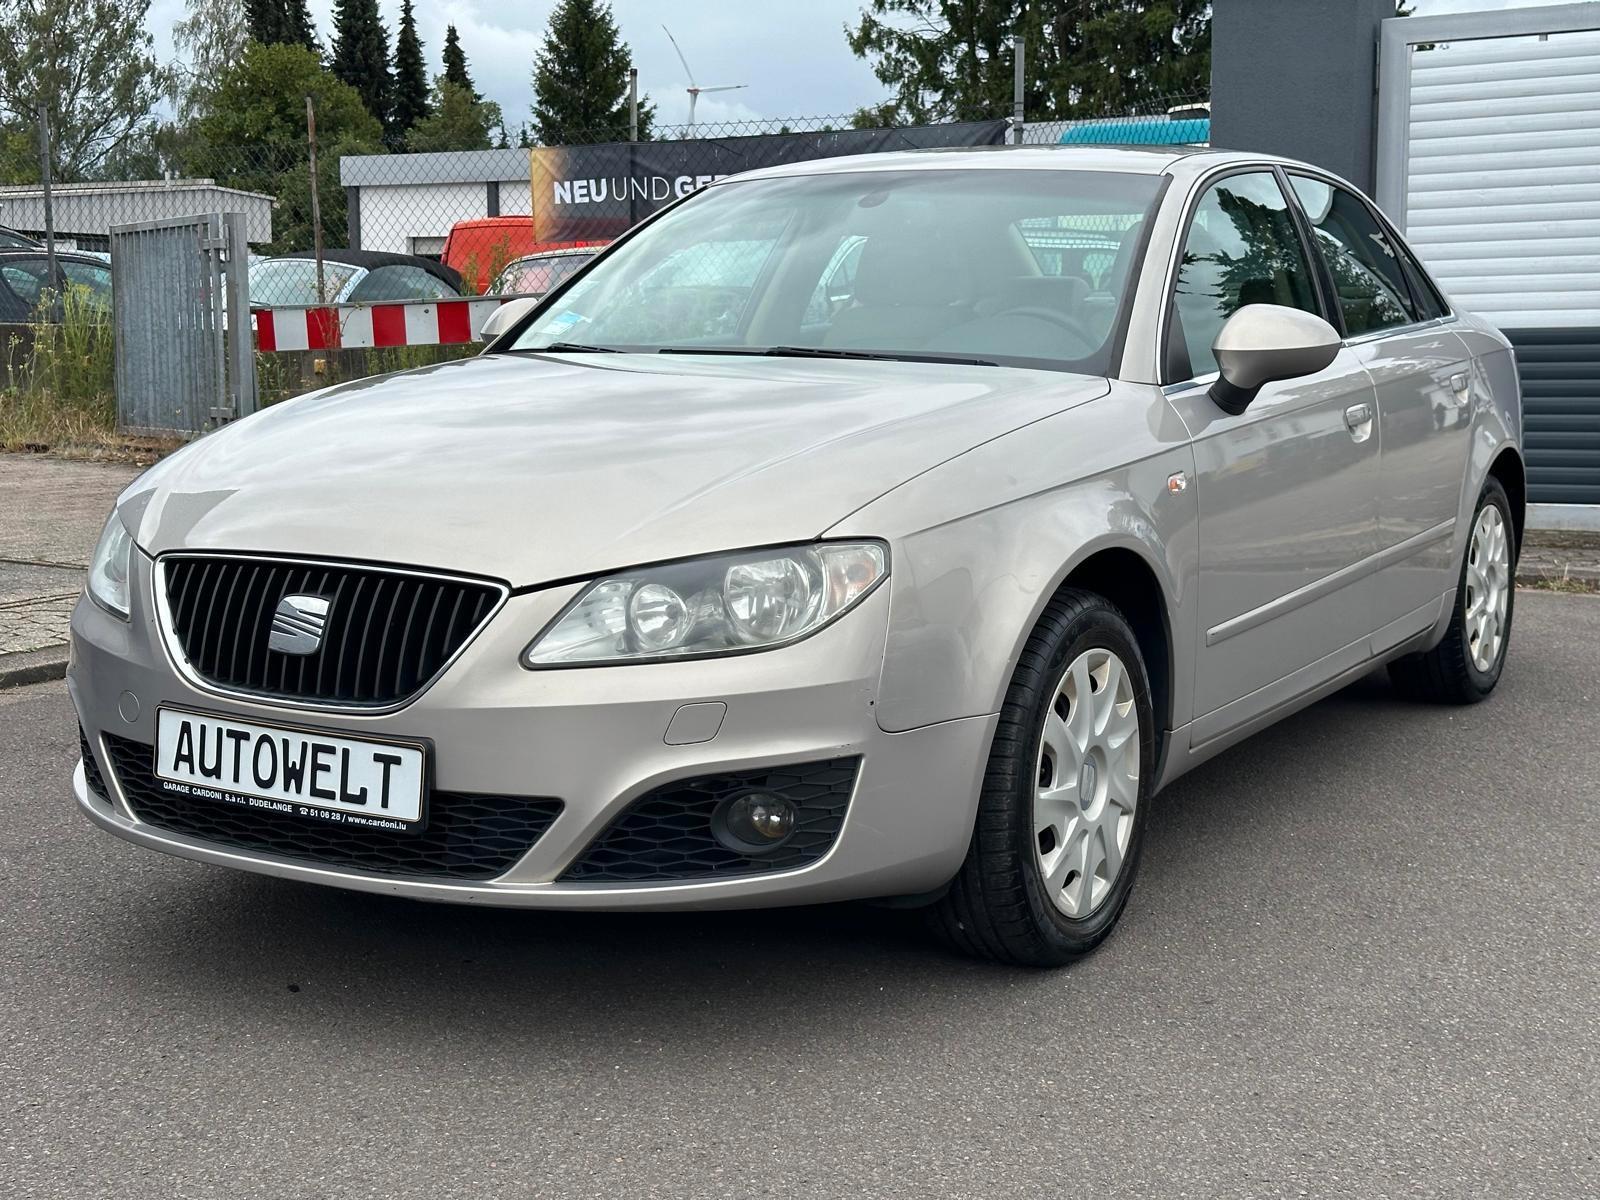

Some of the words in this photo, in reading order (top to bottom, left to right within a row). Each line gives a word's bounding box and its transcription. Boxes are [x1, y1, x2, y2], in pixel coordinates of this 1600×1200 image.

[553, 178, 608, 205] NEU
[612, 176, 670, 201] UND
[674, 174, 729, 200] GE
[173, 720, 402, 809] AUTOWELT
[163, 781, 190, 794] GARAGE
[192, 787, 222, 800] CARDONI
[249, 798, 293, 812] DUDELANGE
[310, 808, 318, 817] 51
[331, 812, 341, 821] 28
[347, 815, 407, 830] www.cardoni.lu
